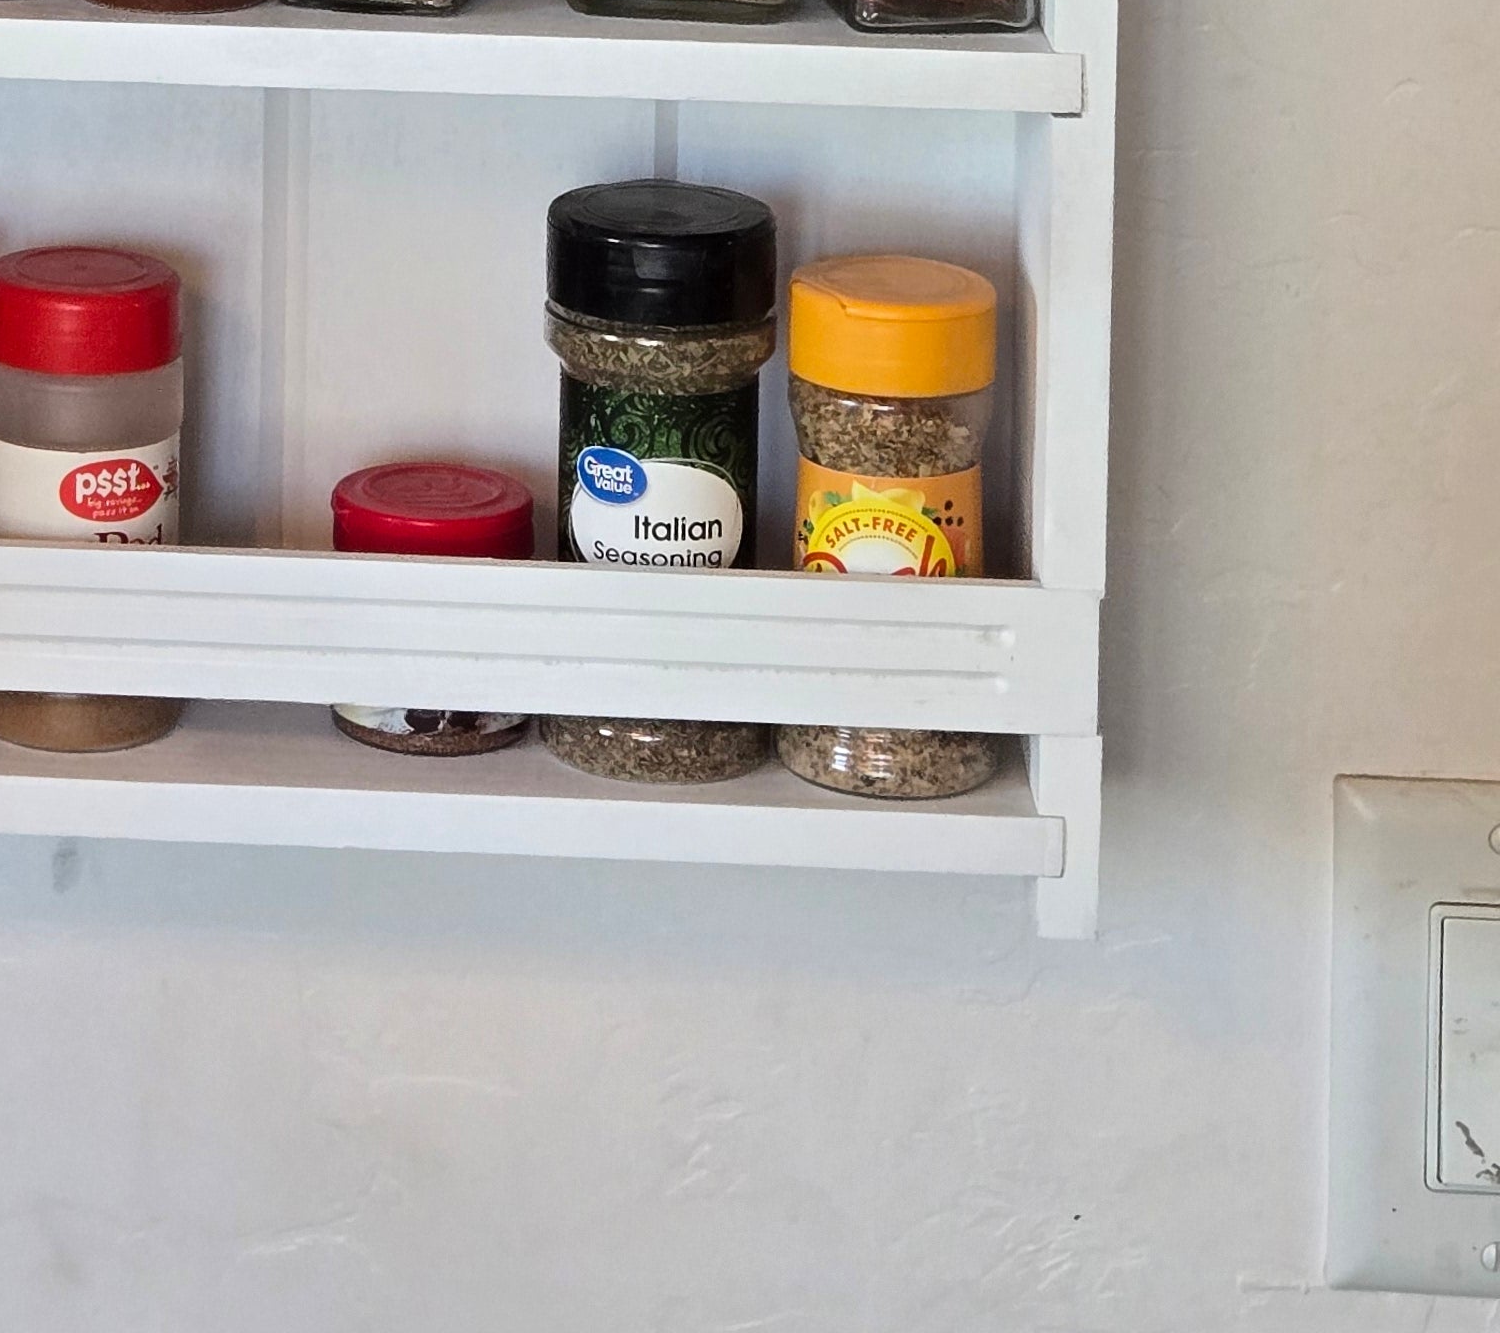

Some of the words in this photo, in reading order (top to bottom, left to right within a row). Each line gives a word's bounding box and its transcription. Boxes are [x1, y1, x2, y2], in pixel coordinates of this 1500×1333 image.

[584, 456, 633, 482] Great
[594, 476, 633, 494] Value
[634, 515, 723, 541] Italian
[825, 516, 918, 548] SALT-FREE
[593, 540, 723, 567] Seasoning
